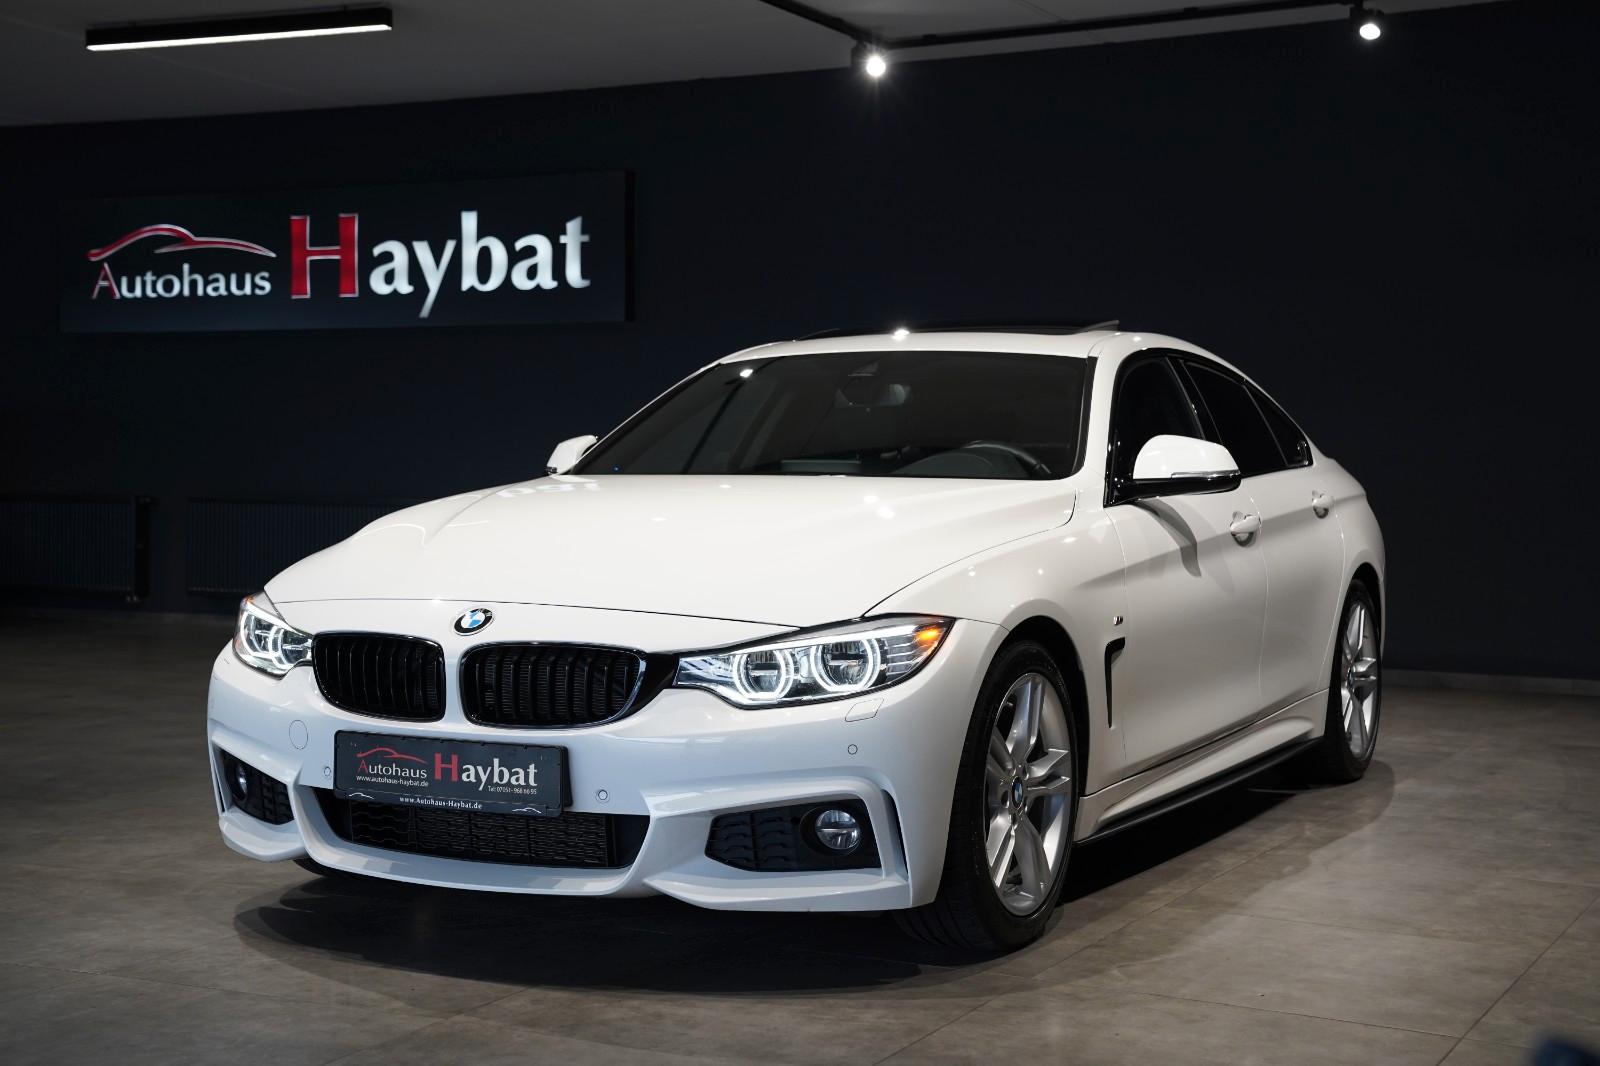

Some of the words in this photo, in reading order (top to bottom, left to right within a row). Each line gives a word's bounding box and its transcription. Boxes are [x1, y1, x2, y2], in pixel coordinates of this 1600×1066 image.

[93, 262, 271, 299] Autohaus
[290, 210, 591, 319] Haybat
[356, 775, 429, 787] www.autohaus-haybat.de
[358, 759, 427, 780] Autohaus
[434, 753, 537, 791] Haybat
[399, 796, 483, 810] www.Autohaus-Haybat.de
